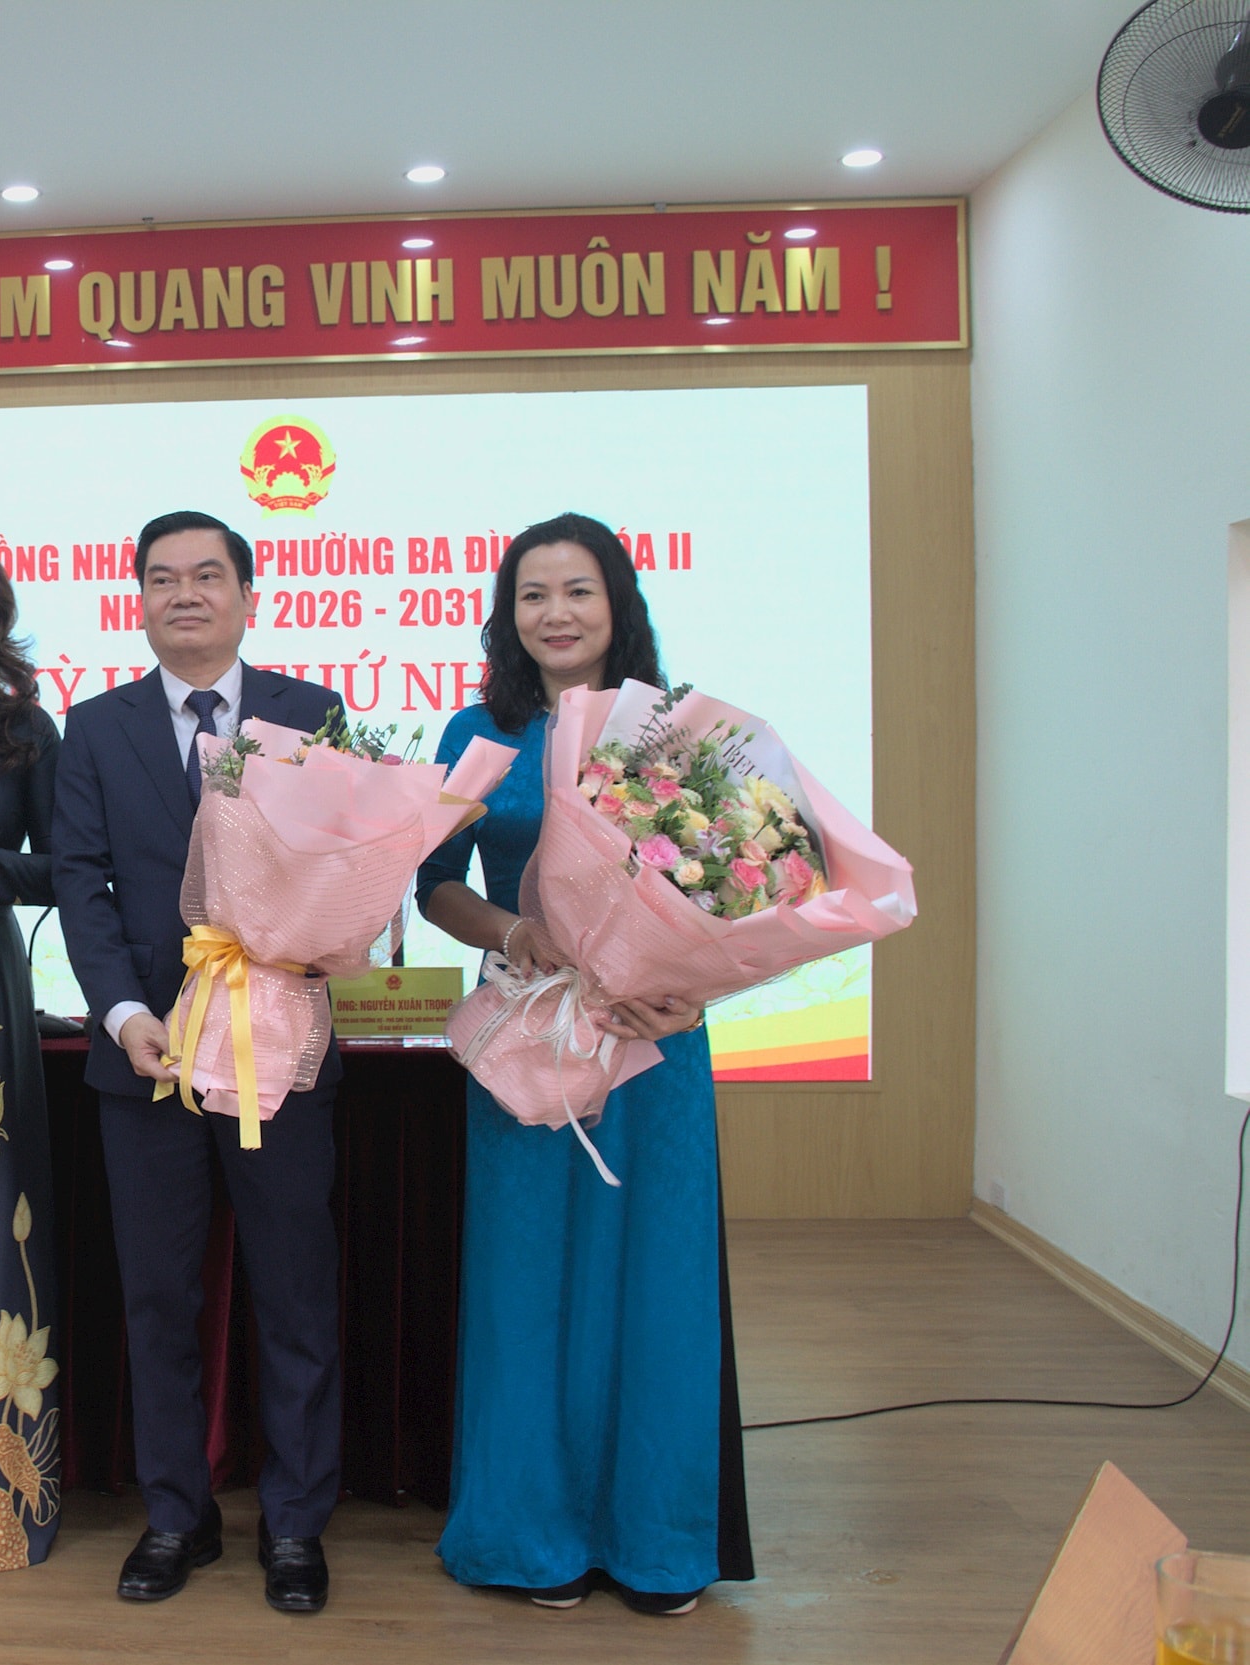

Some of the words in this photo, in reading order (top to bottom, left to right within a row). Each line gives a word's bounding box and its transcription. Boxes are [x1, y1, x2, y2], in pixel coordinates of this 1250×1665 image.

[78, 264, 286, 341] QUANG
[310, 258, 455, 326] VINH
[481, 236, 667, 322] MUÔN
[693, 231, 842, 315] NĂM
[875, 245, 894, 311] !
[73, 536, 138, 580] NHÂ
[255, 532, 394, 577] PHƯỜNG
[408, 537, 453, 574] BA
[464, 529, 518, 573] ĐÌ
[669, 533, 691, 570] II
[273, 590, 362, 629] 2026
[399, 588, 483, 626] 2031
[400, 662, 488, 711] NH
